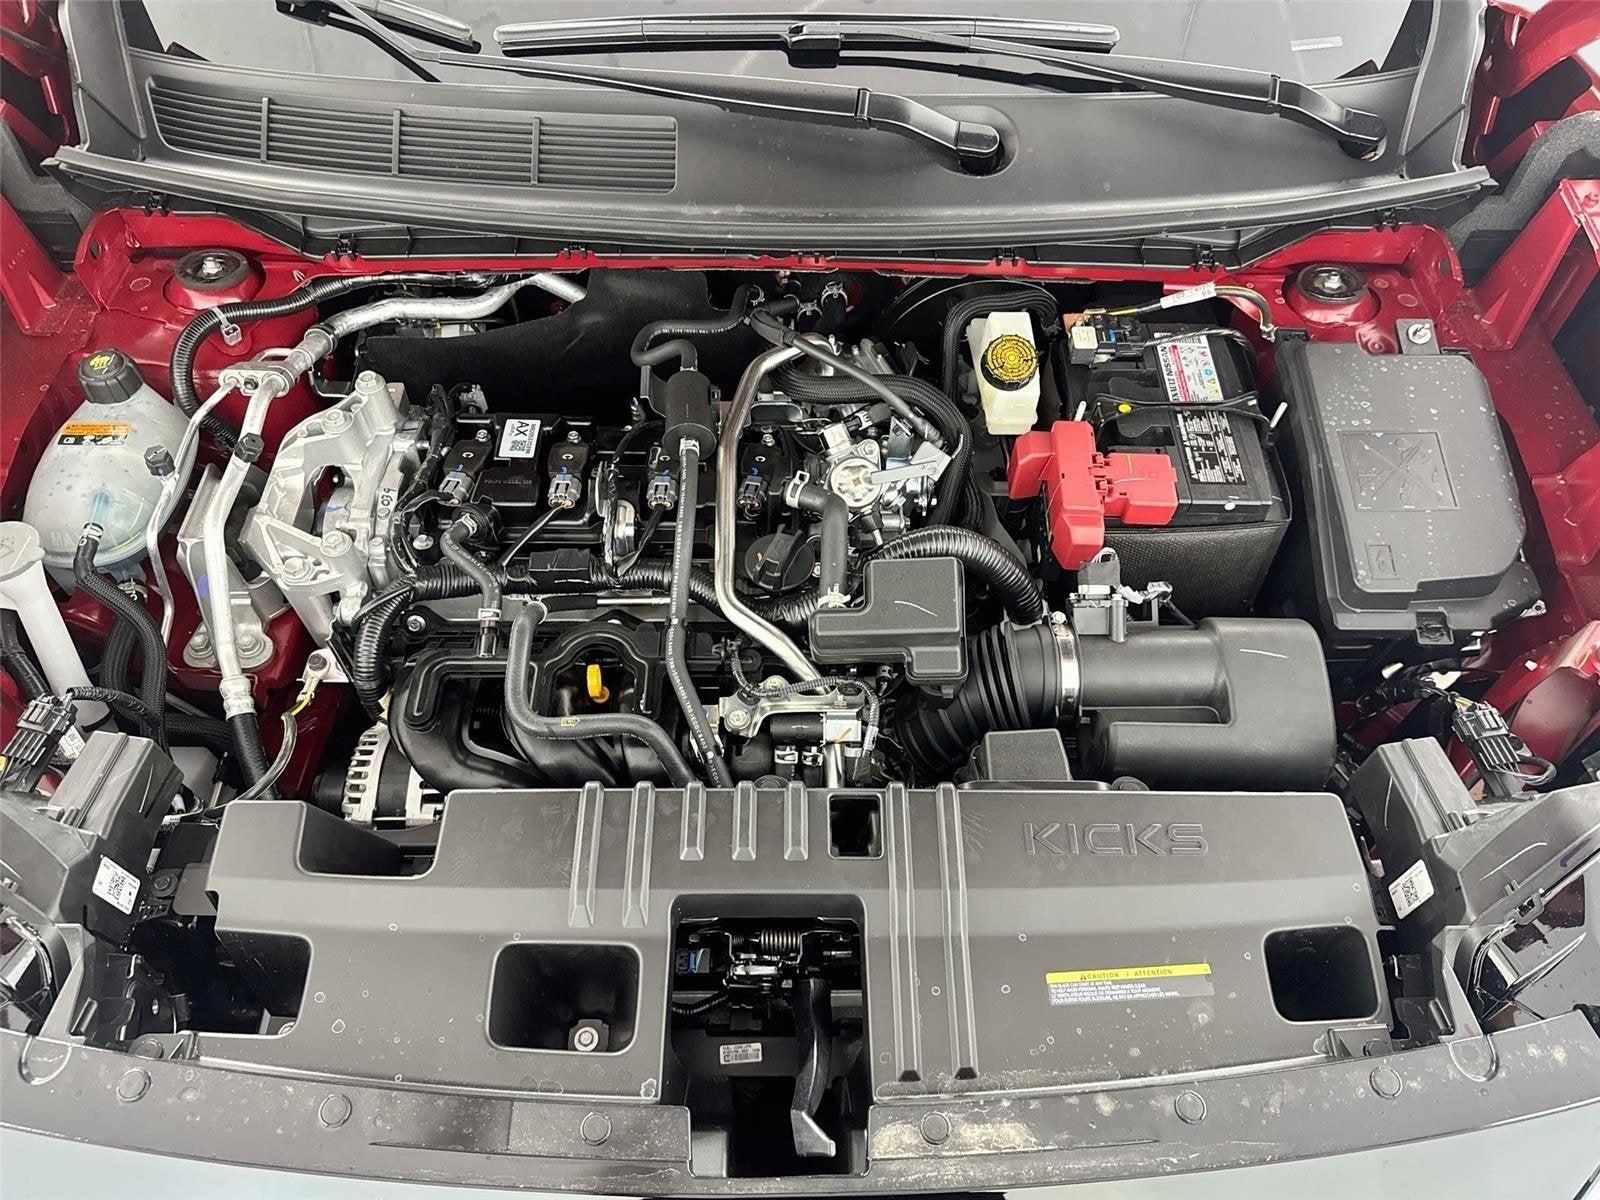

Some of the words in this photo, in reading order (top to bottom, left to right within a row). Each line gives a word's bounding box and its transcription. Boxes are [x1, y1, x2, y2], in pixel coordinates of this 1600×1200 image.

[1159, 346, 1174, 377] NISSAN
[515, 421, 530, 437] AX
[1024, 822, 1208, 856] KICKS
[1086, 972, 1119, 980] CAUTION
[1134, 969, 1173, 977] ATTENTION
